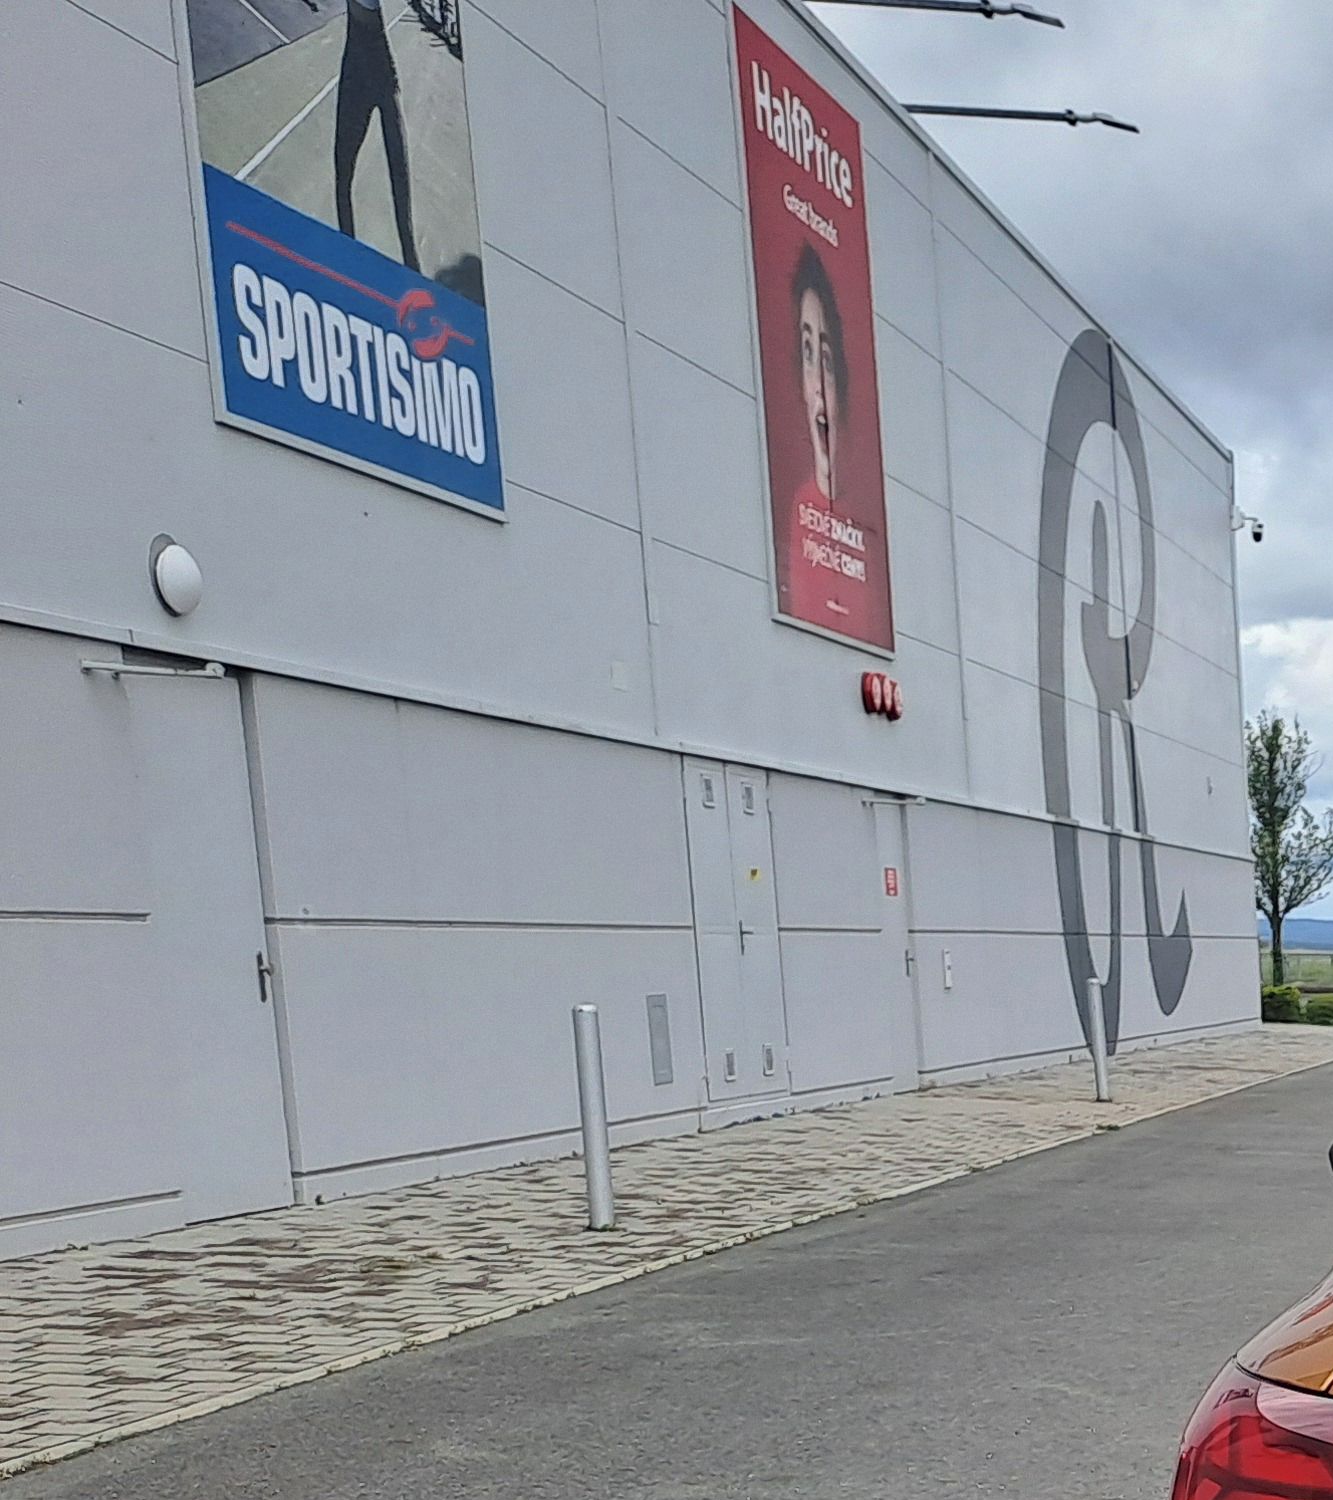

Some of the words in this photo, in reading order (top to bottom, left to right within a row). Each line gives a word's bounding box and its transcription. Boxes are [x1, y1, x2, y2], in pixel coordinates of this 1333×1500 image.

[752, 60, 854, 209] HalfPrice
[783, 184, 810, 225] Great
[808, 202, 839, 248] brands
[231, 262, 486, 465] SPORTISIMO
